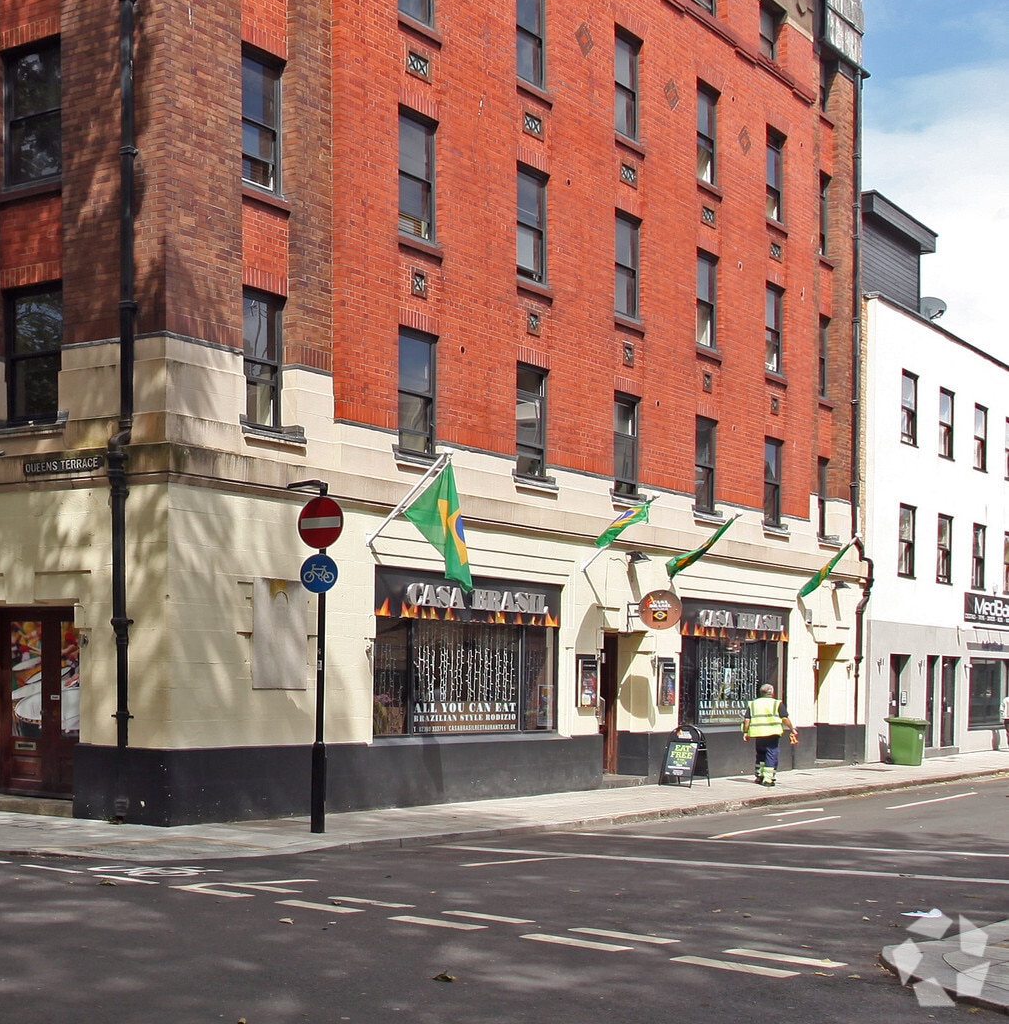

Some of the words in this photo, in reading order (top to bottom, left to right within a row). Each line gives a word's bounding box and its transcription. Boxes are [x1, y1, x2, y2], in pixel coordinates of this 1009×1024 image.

[25, 460, 58, 473] QUEENS
[60, 457, 99, 470] TERRACE
[406, 582, 466, 610] CASA
[470, 588, 549, 614] BRASIL
[699, 609, 735, 628] CASA
[736, 612, 784, 632] BRASIL
[413, 702, 438, 713] ALL
[440, 702, 465, 713] YOU
[468, 702, 492, 713] CAN
[495, 702, 517, 713] EAT
[699, 700, 713, 709] ALL
[413, 714, 458, 723] BRAZILIAN
[459, 714, 484, 722] STYLE
[485, 713, 517, 722] RODIZIO
[674, 744, 693, 752] EAT
[670, 751, 694, 760] FREE
